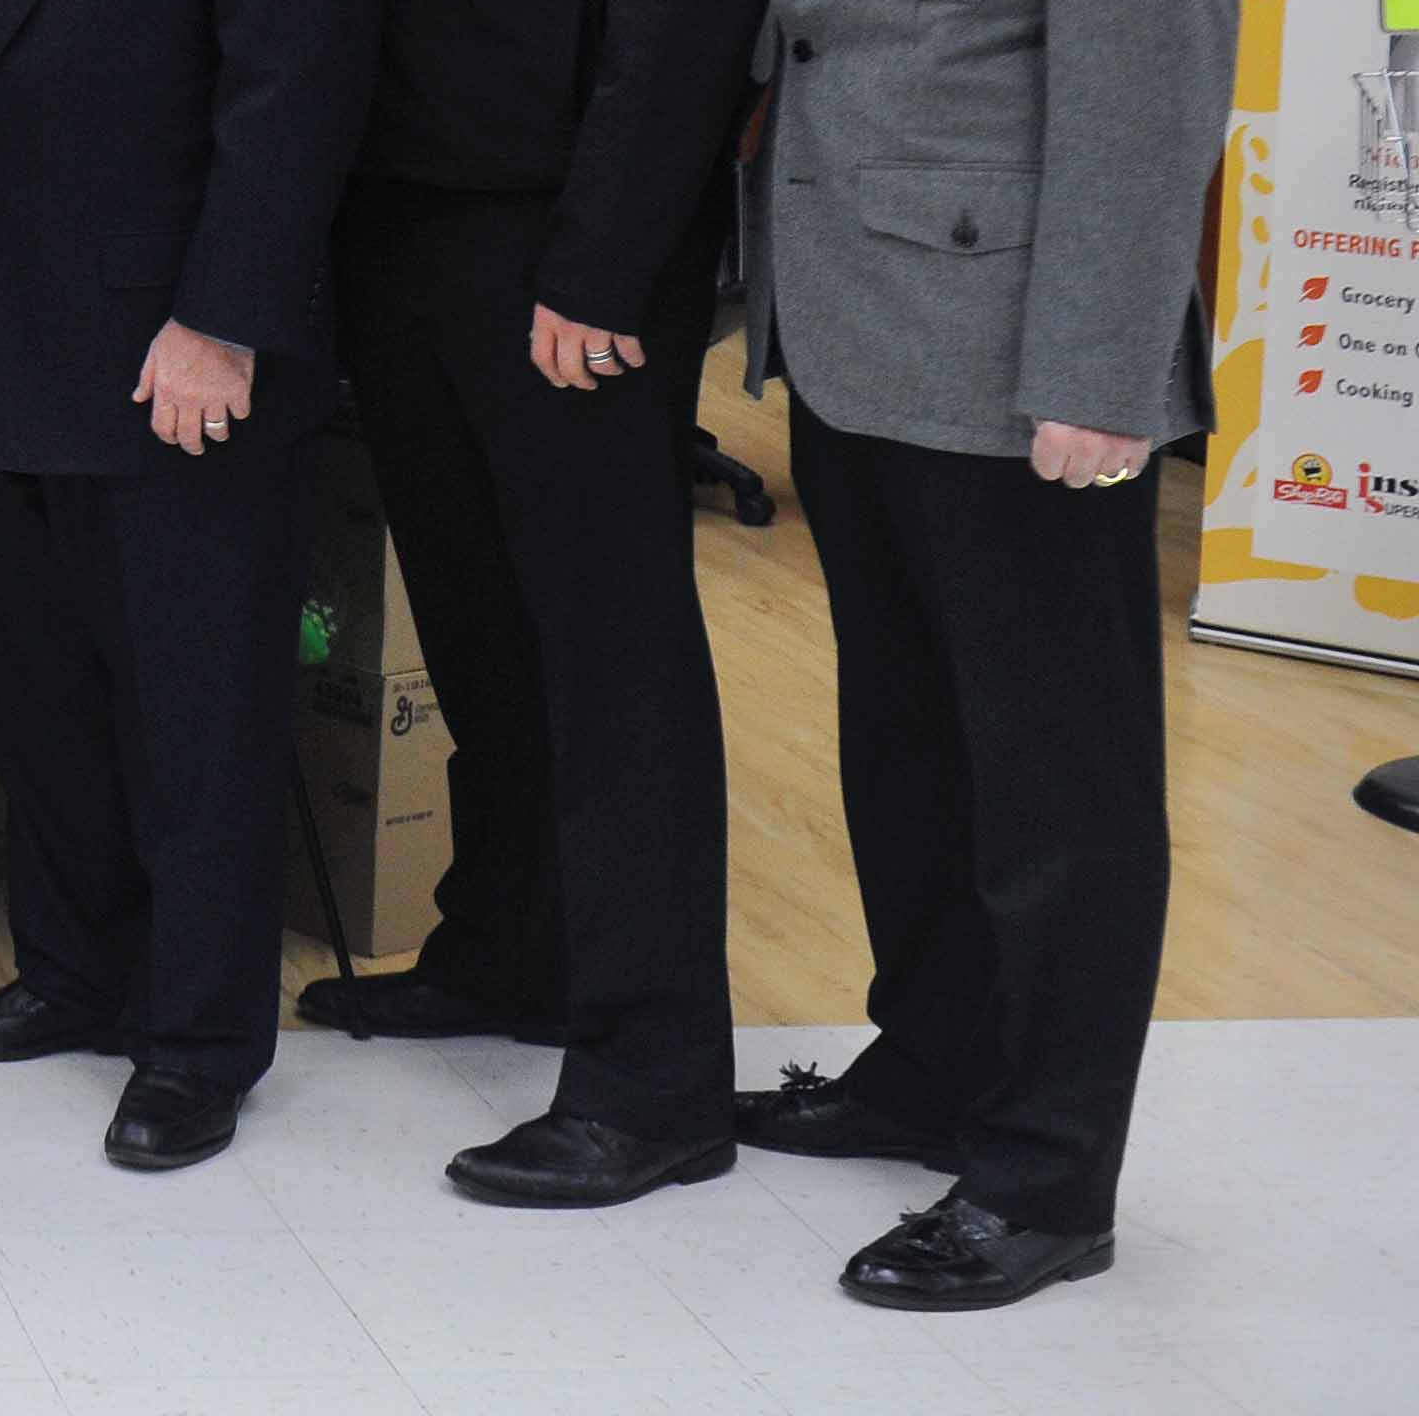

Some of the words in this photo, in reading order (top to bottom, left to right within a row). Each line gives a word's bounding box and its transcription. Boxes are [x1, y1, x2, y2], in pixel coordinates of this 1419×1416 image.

[1294, 229, 1401, 258] OFFERING
[1341, 286, 1415, 315] Grocery
[1339, 333, 1376, 353] One
[1383, 342, 1407, 357] on
[1336, 378, 1413, 408] Cooking
